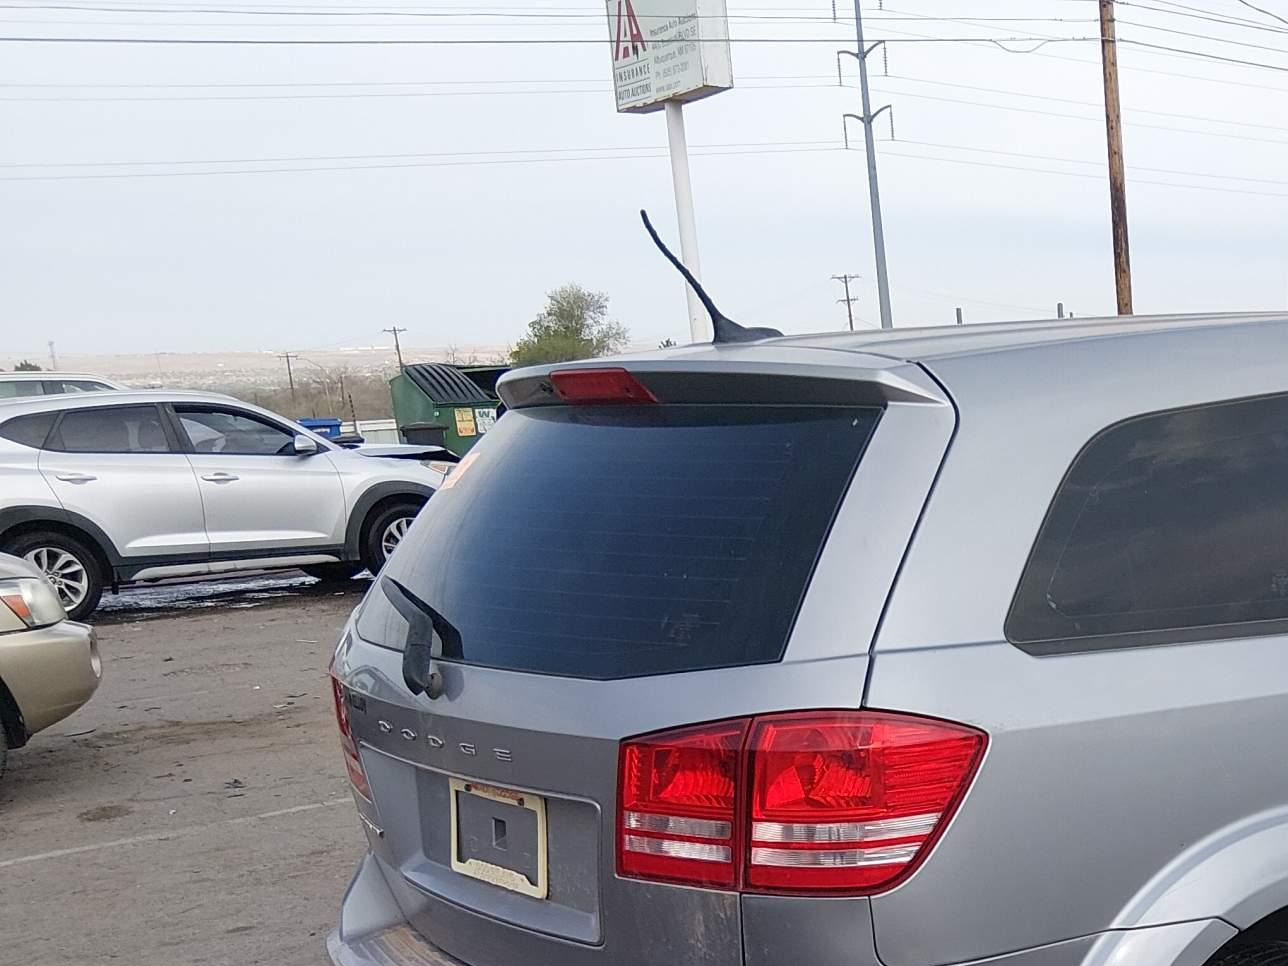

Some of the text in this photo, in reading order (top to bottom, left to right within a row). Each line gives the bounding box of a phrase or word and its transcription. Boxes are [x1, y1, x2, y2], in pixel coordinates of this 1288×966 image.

[616, 63, 651, 83] INSURANCE
[618, 89, 631, 101] AUTO
[631, 82, 652, 97] AUCTIONS
[378, 720, 513, 763] DODGE
